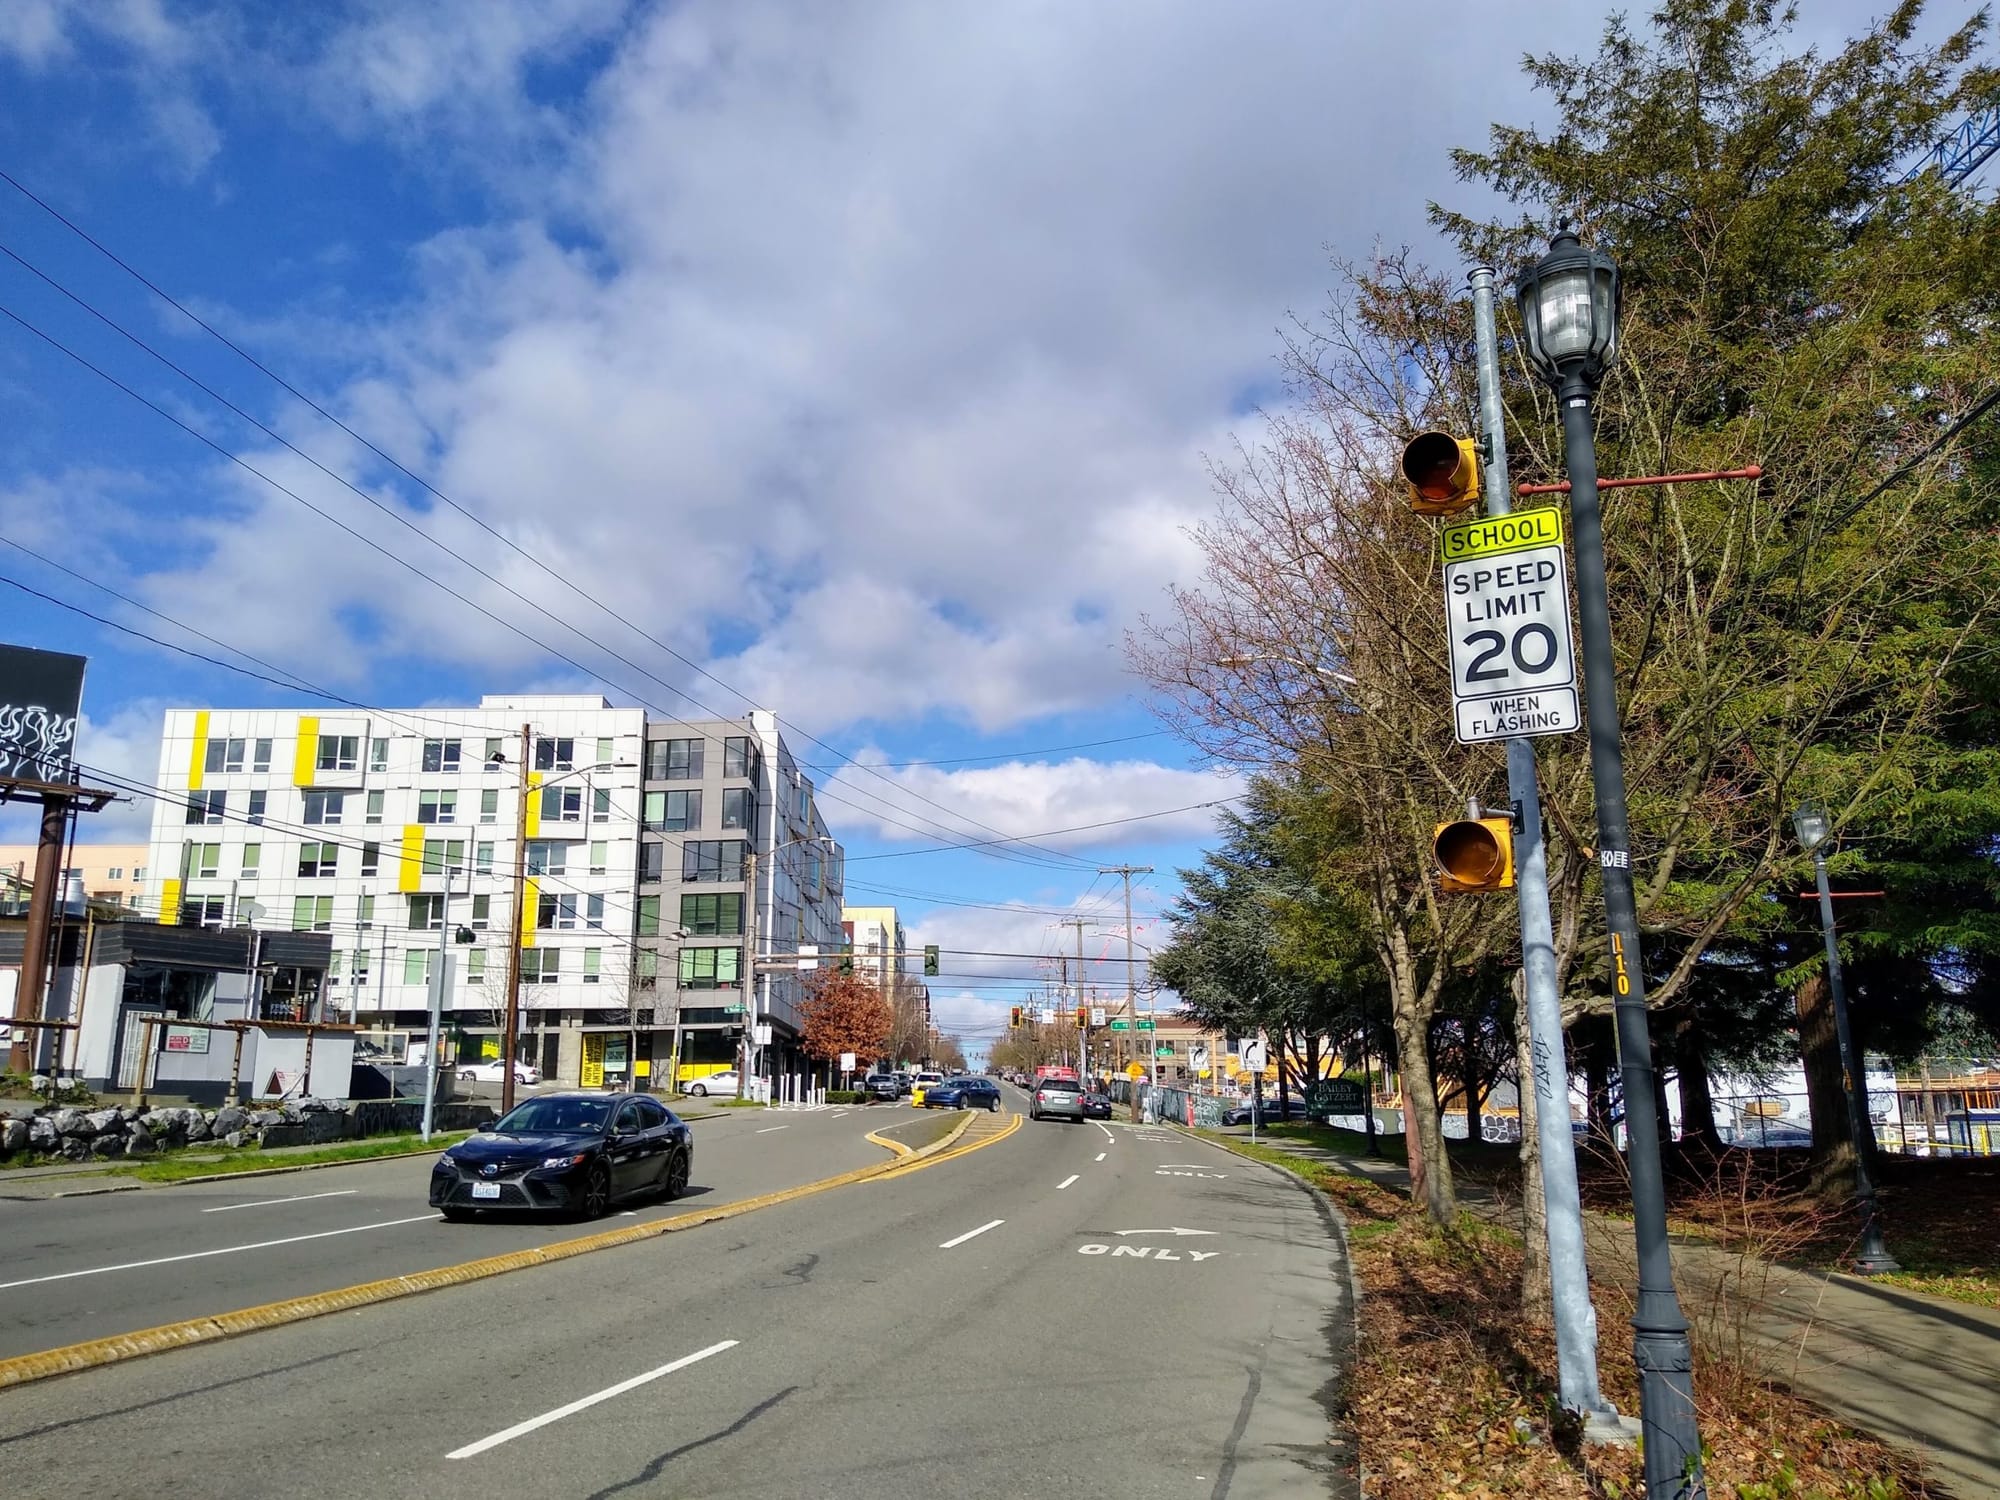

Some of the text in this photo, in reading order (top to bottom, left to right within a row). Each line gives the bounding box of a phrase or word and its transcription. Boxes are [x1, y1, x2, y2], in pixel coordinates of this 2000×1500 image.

[1451, 518, 1551, 551] SCHOOL
[1453, 560, 1556, 595] SPEED
[1466, 591, 1546, 622] LIMIT
[1462, 622, 1558, 683] 20
[1490, 696, 1540, 715] WHEN
[1472, 711, 1561, 735] FLASHING
[1314, 1092, 1358, 1101] GATZERT
[1318, 1082, 1353, 1092] BAILEY
[1155, 1170, 1229, 1179] ONLY
[1078, 1244, 1221, 1261] ONLY
